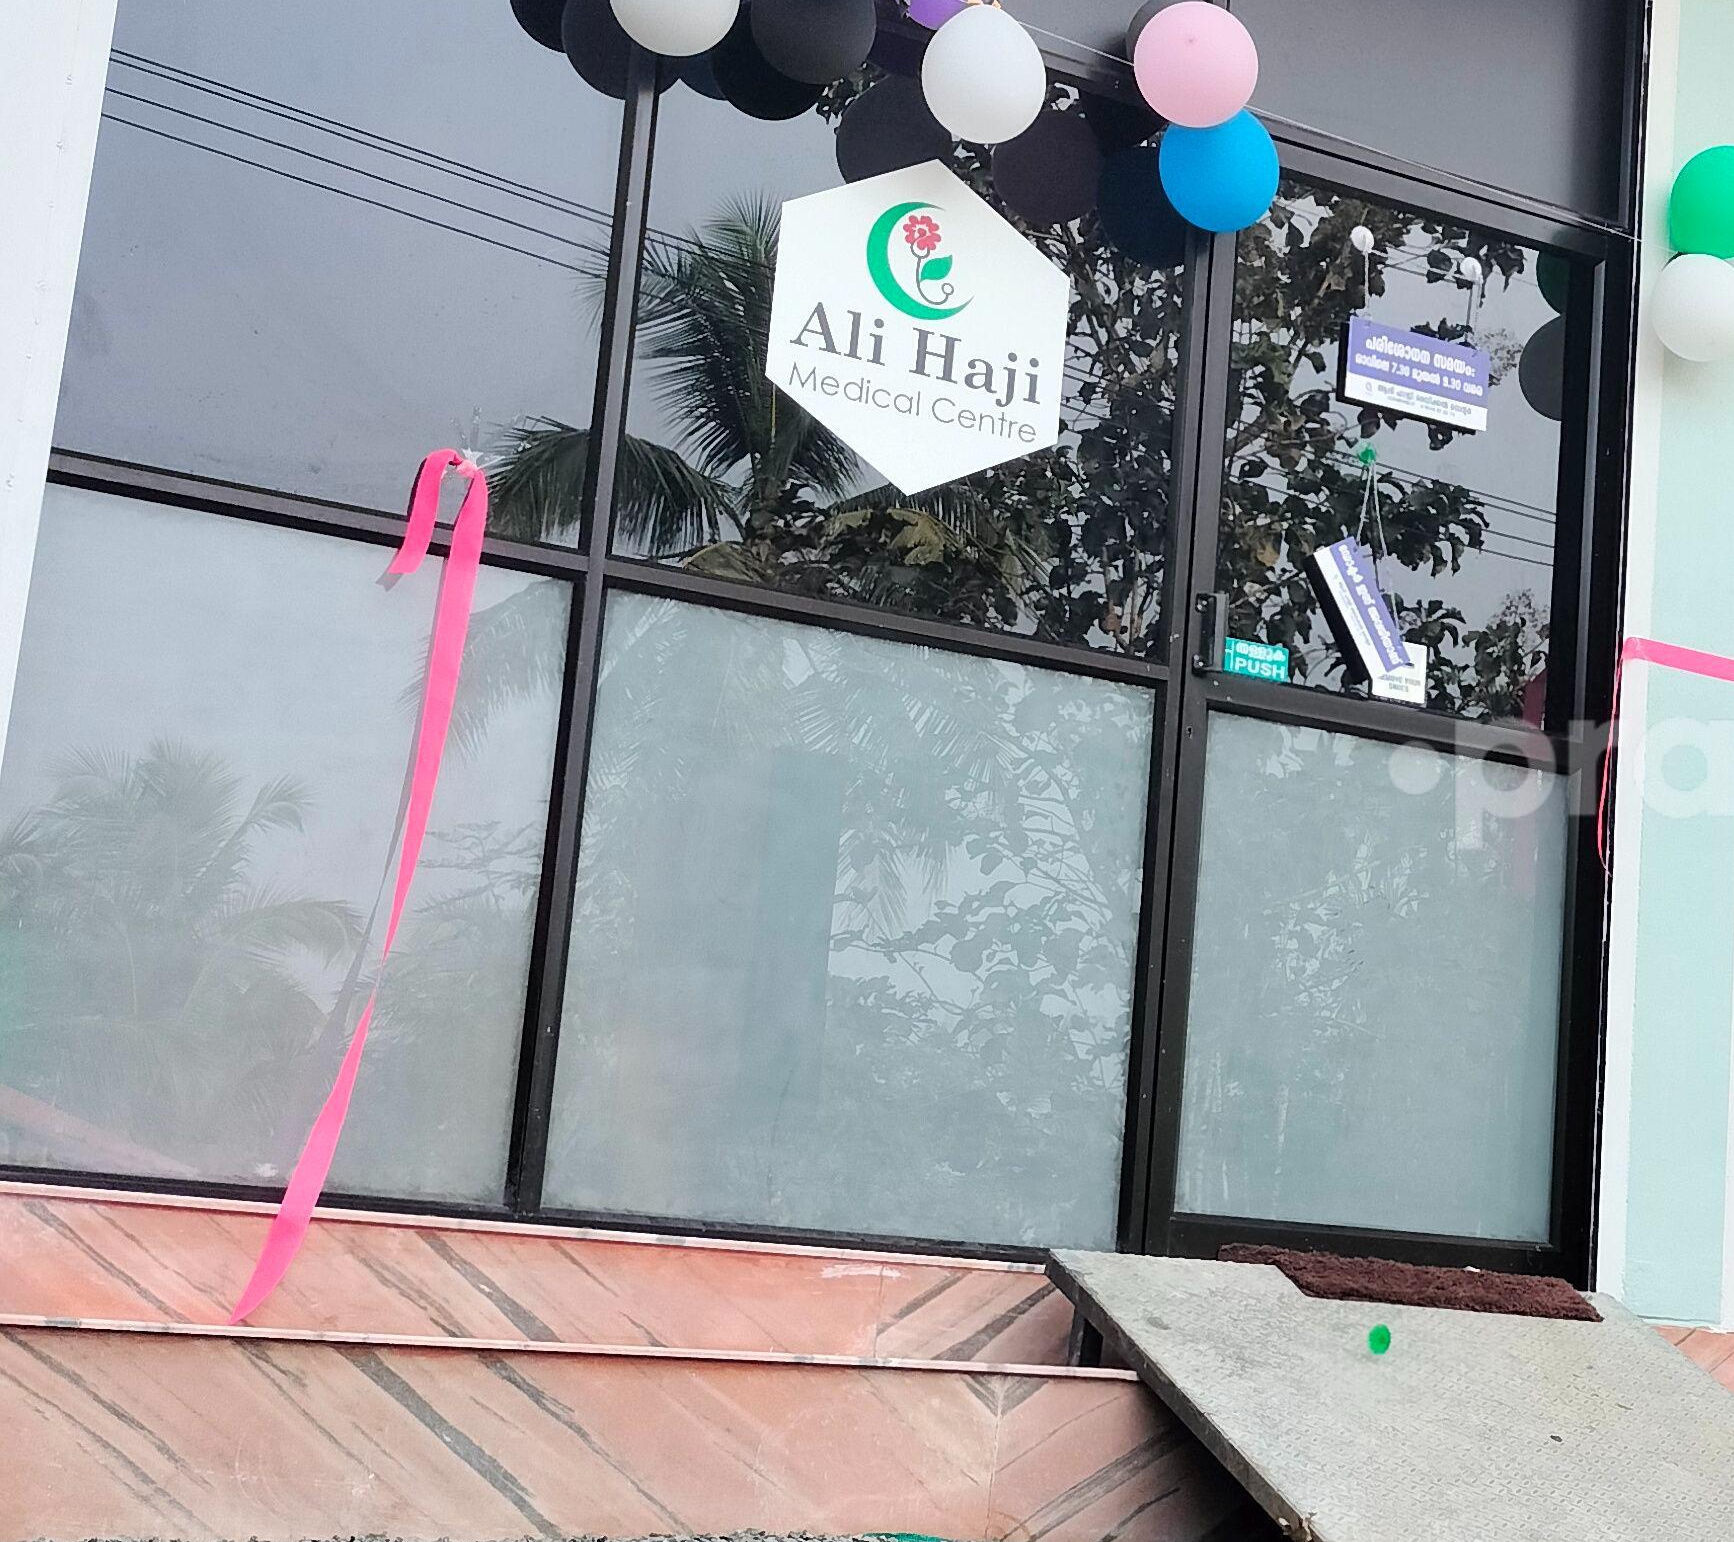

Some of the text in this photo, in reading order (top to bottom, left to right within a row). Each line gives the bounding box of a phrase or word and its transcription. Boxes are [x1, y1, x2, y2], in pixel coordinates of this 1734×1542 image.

[789, 301, 1042, 408] Ali Haji
[788, 362, 1037, 444] Medical Centre
[1233, 657, 1286, 681] PUSH
